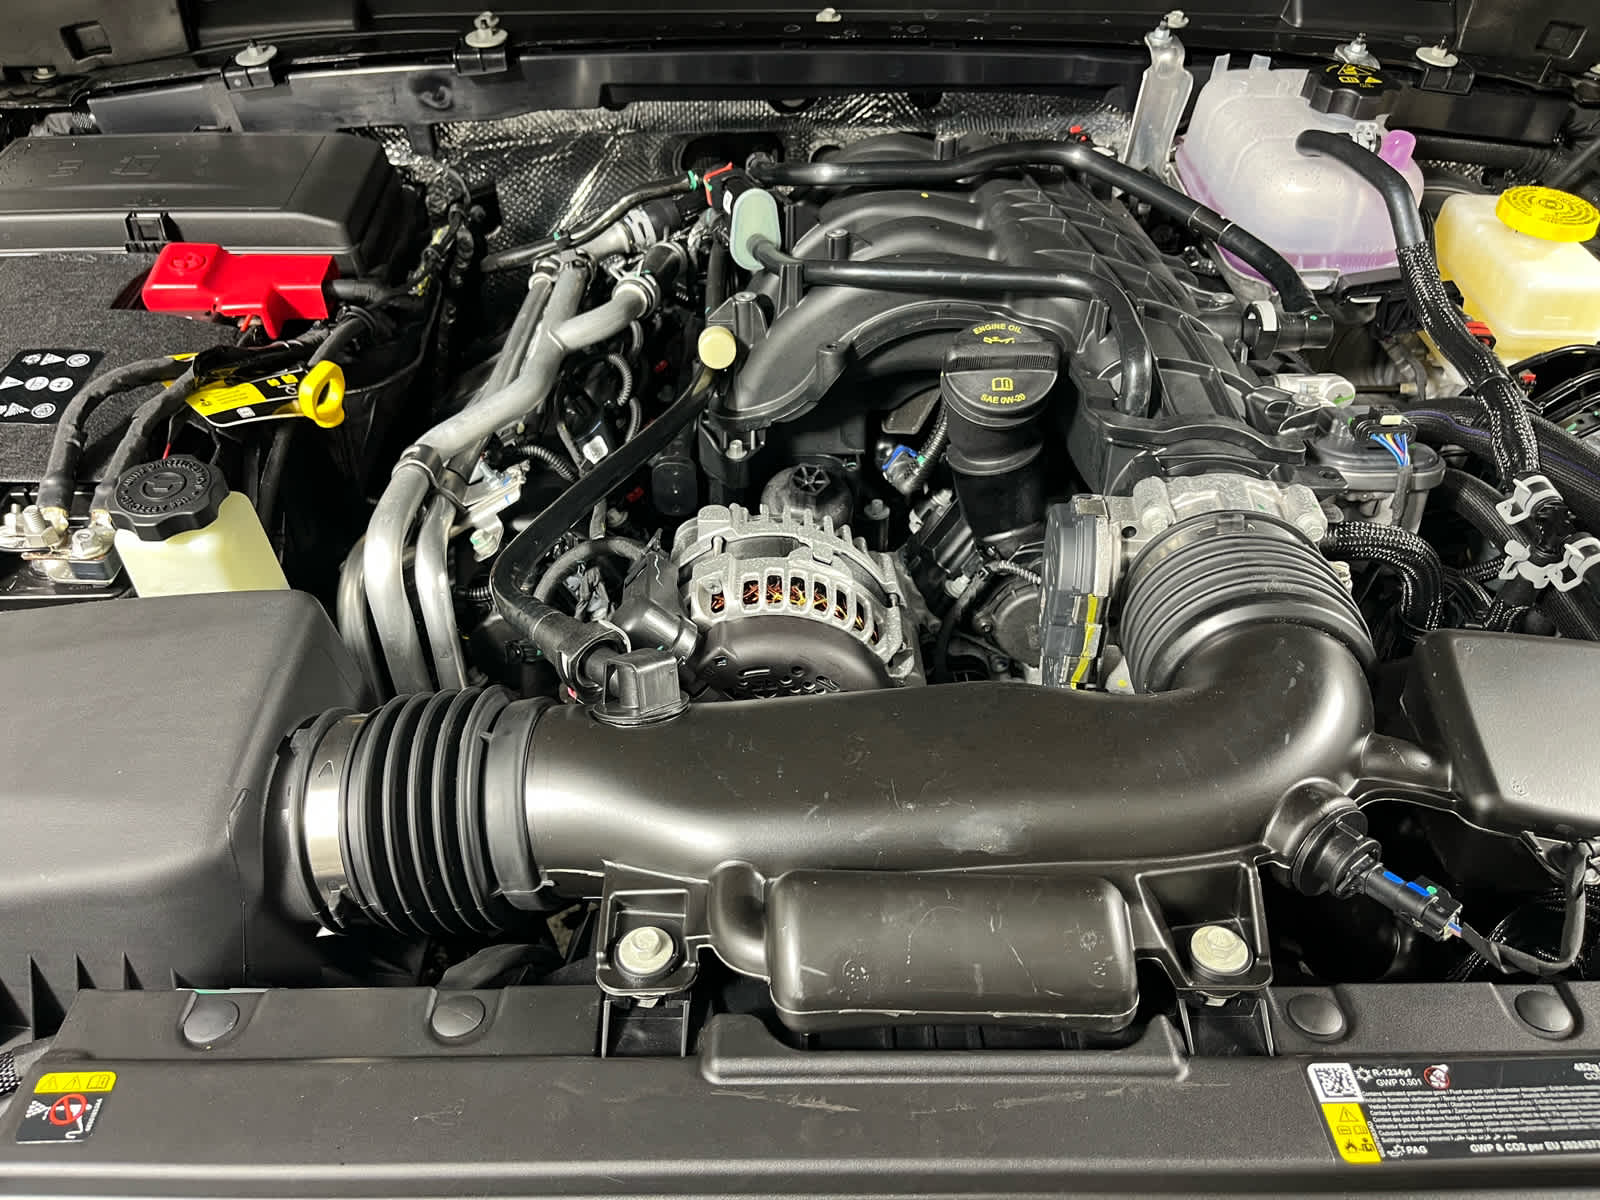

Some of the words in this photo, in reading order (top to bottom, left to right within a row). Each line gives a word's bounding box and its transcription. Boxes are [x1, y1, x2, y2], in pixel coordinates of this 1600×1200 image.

[973, 323, 1006, 335] ENGINE
[1008, 325, 1022, 334] OIL
[981, 394, 999, 404] SAE
[1000, 393, 1026, 404] 0W-20
[1371, 1067, 1412, 1078] R-1234yf
[1375, 1078, 1398, 1087] GWP
[1399, 1078, 1423, 1087] 0.501
[1405, 1145, 1428, 1154] PAG
[1470, 1143, 1494, 1153] GWP
[1495, 1143, 1505, 1152] &
[1505, 1142, 1527, 1152] CO2
[1544, 1141, 1560, 1151] EU
